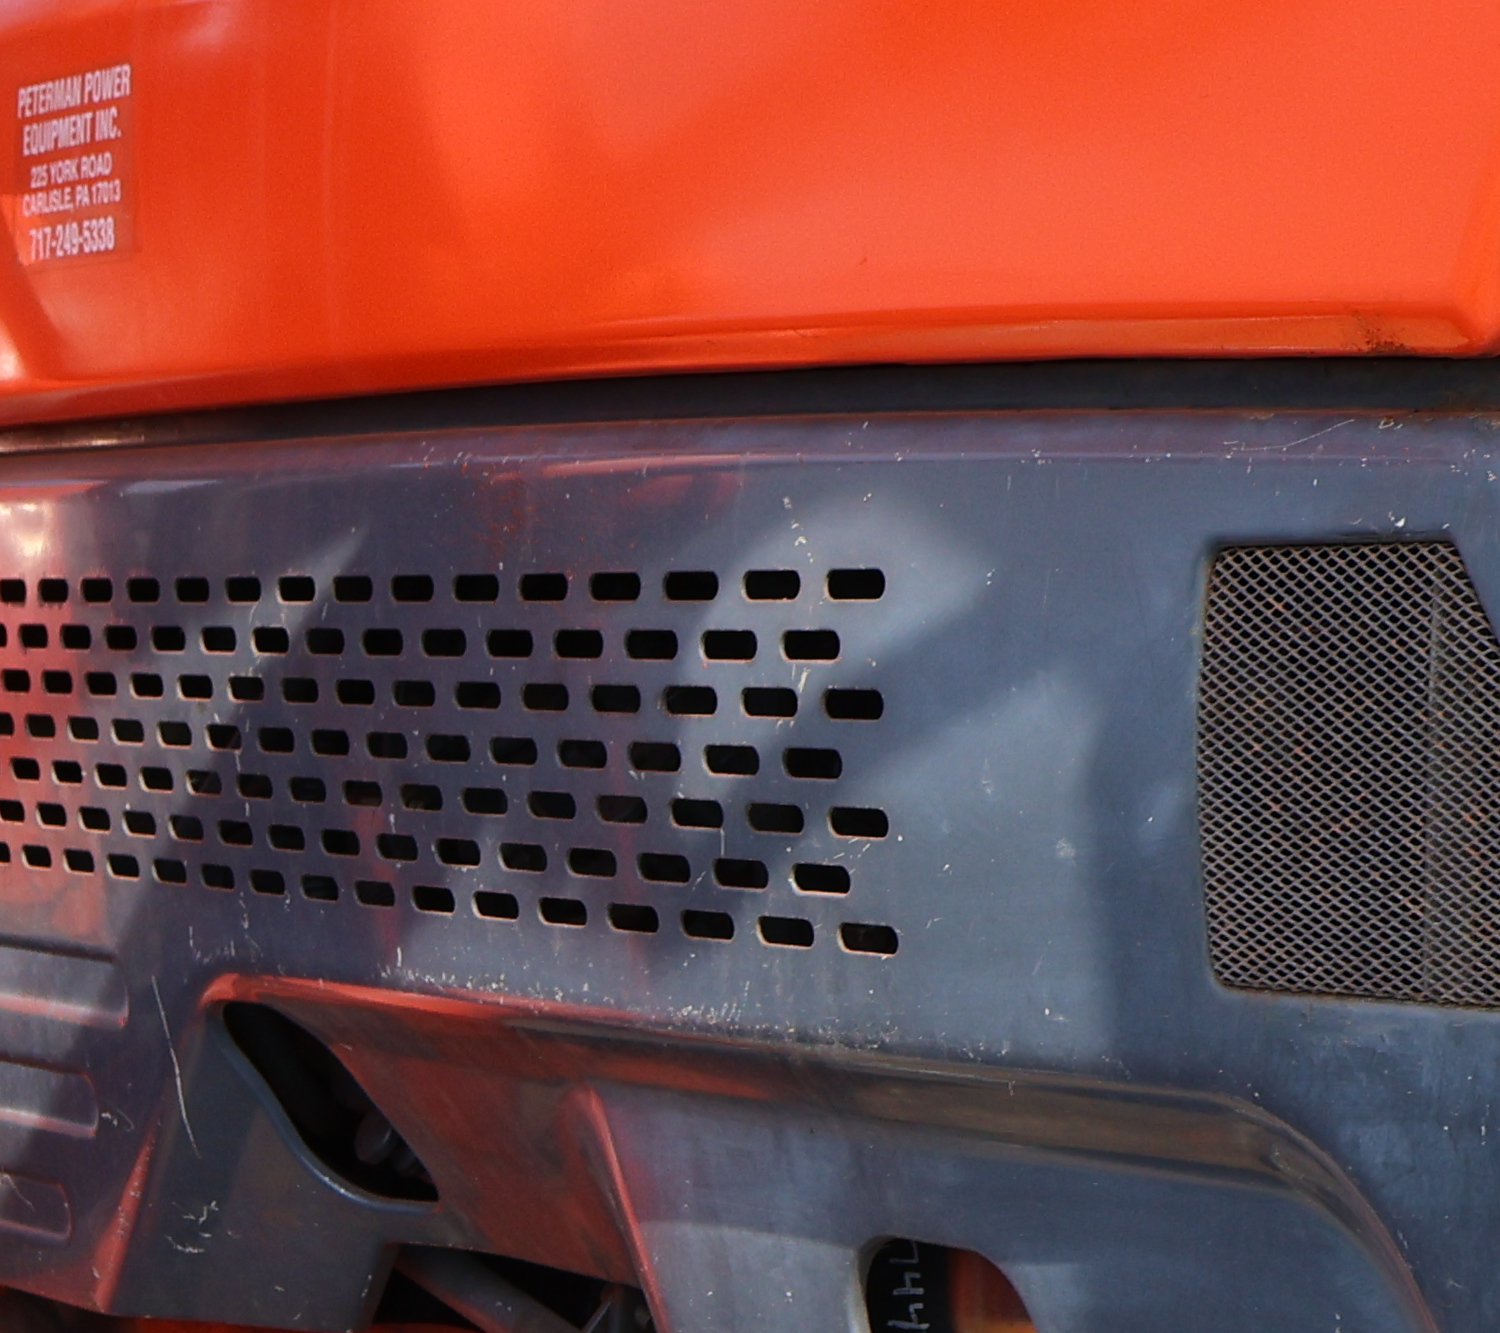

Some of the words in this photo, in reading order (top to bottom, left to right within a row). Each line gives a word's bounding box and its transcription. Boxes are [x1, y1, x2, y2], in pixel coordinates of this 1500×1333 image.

[16, 74, 82, 119] PETERMAN
[83, 63, 131, 104] POWER
[22, 111, 93, 157] EQUIPMENT
[95, 105, 122, 142] INC.
[30, 164, 48, 190] 225
[49, 158, 79, 184] YORK
[80, 151, 112, 180] ROAD
[75, 183, 90, 207] PA
[91, 178, 121, 206] 17013
[29, 215, 115, 263] 717-249-5338
